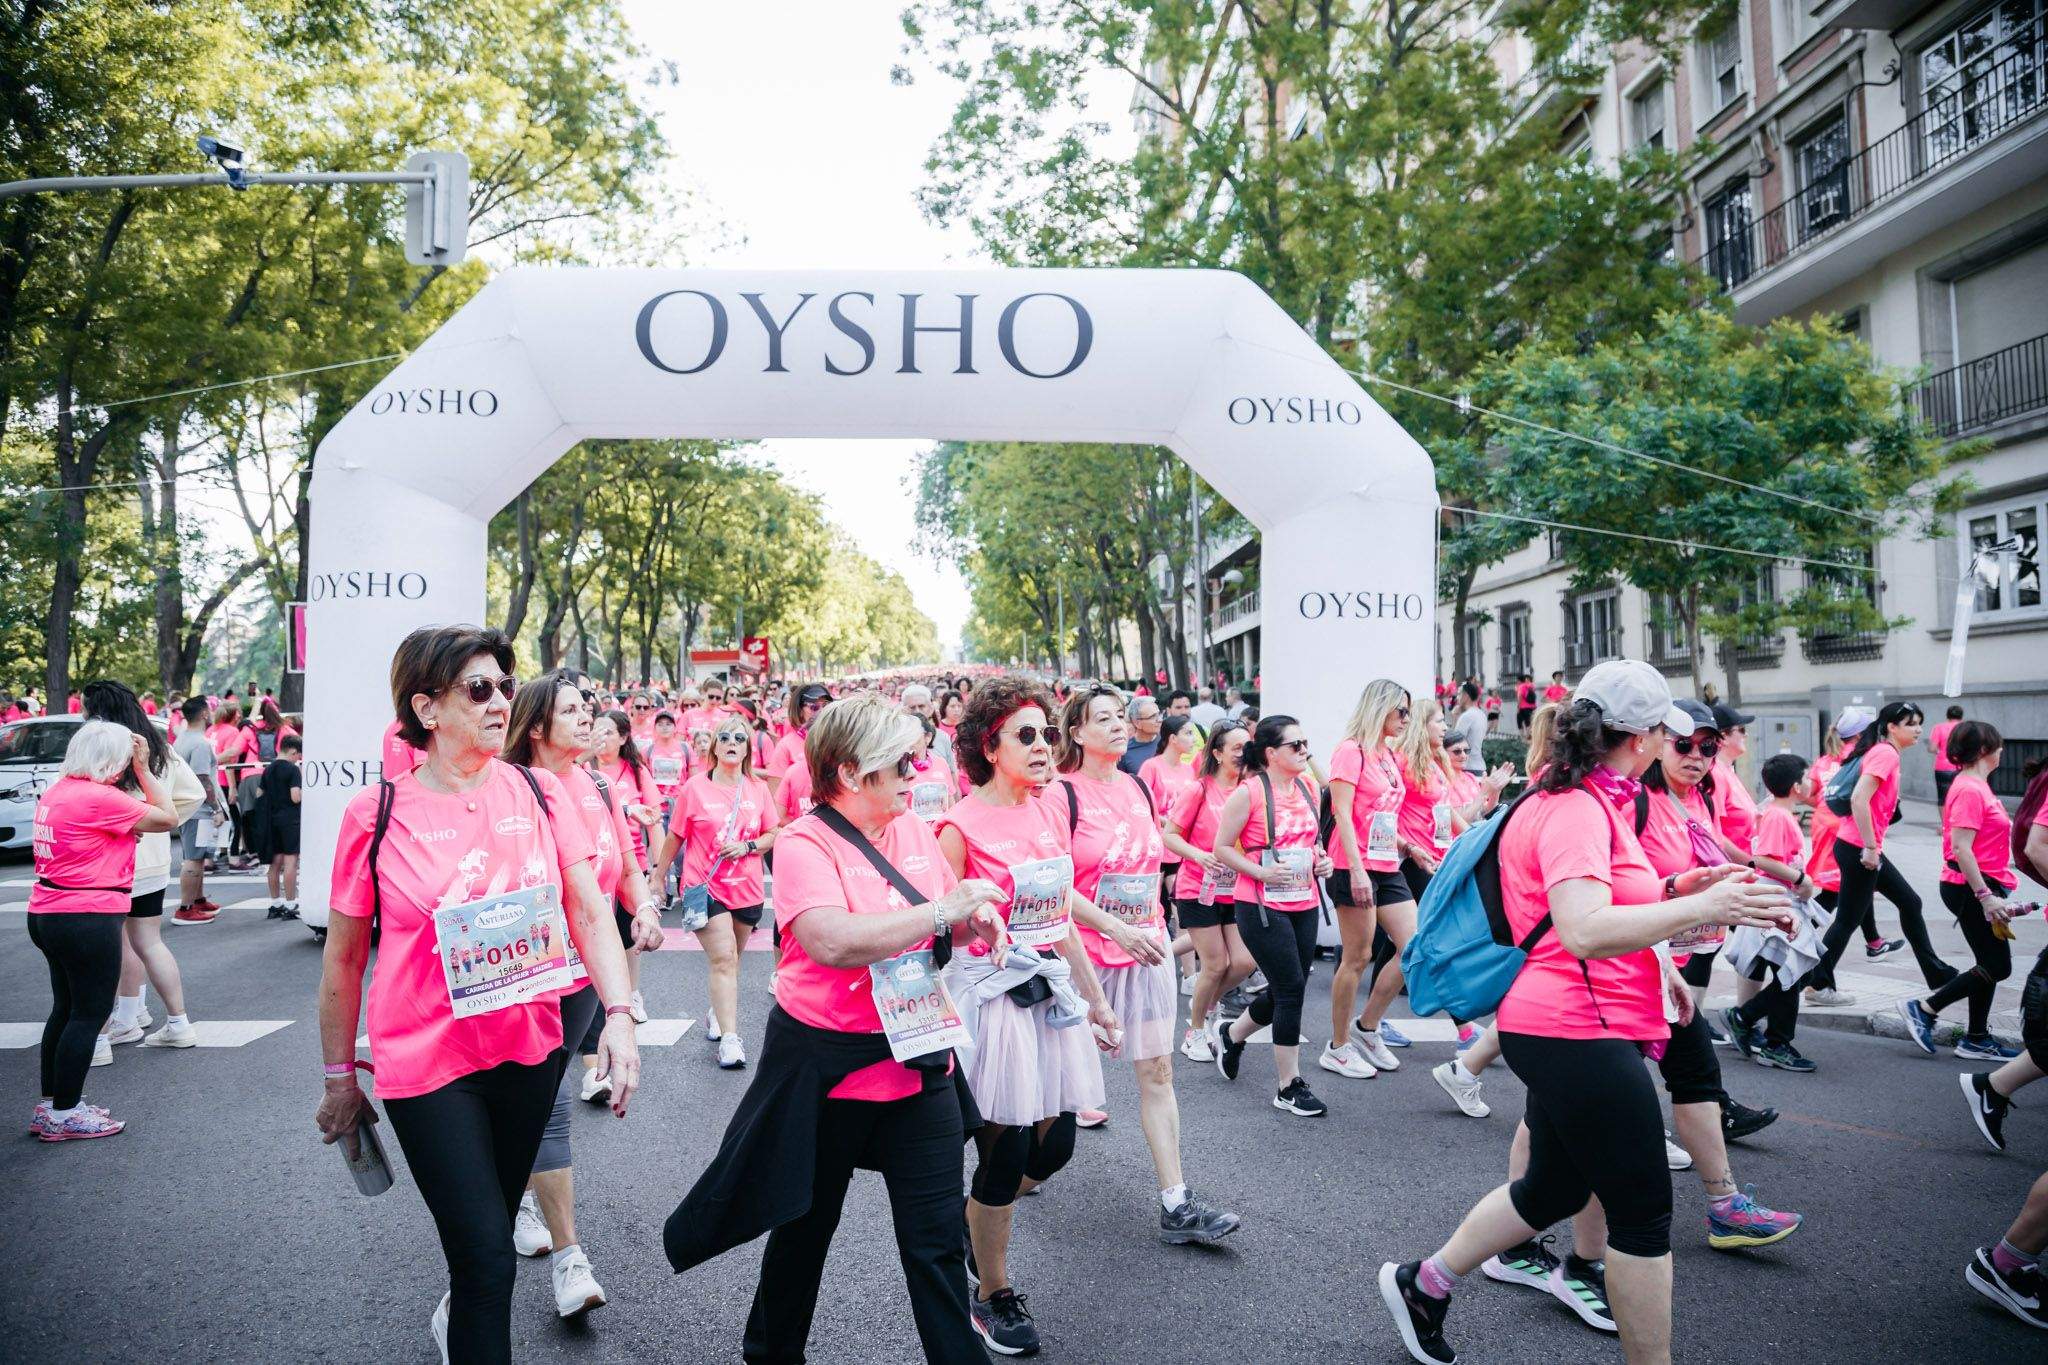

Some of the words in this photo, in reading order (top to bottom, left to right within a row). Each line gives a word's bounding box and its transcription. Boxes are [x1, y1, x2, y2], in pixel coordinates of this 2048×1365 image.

[635, 290, 1094, 379] OYSHO
[371, 388, 498, 417] OYSHO
[1228, 397, 1361, 425] OYSHO
[311, 571, 427, 601] OYSHO
[1299, 591, 1422, 621] OYSHO
[306, 760, 384, 788] OYSH
[1035, 896, 1057, 912] 016
[1120, 904, 1142, 915] 016
[486, 939, 529, 965] 016
[499, 962, 523, 976] 15649
[465, 983, 494, 994] CARRERA
[504, 977, 512, 985] LA
[467, 992, 506, 1009] OYSHO
[908, 993, 940, 1014] 016
